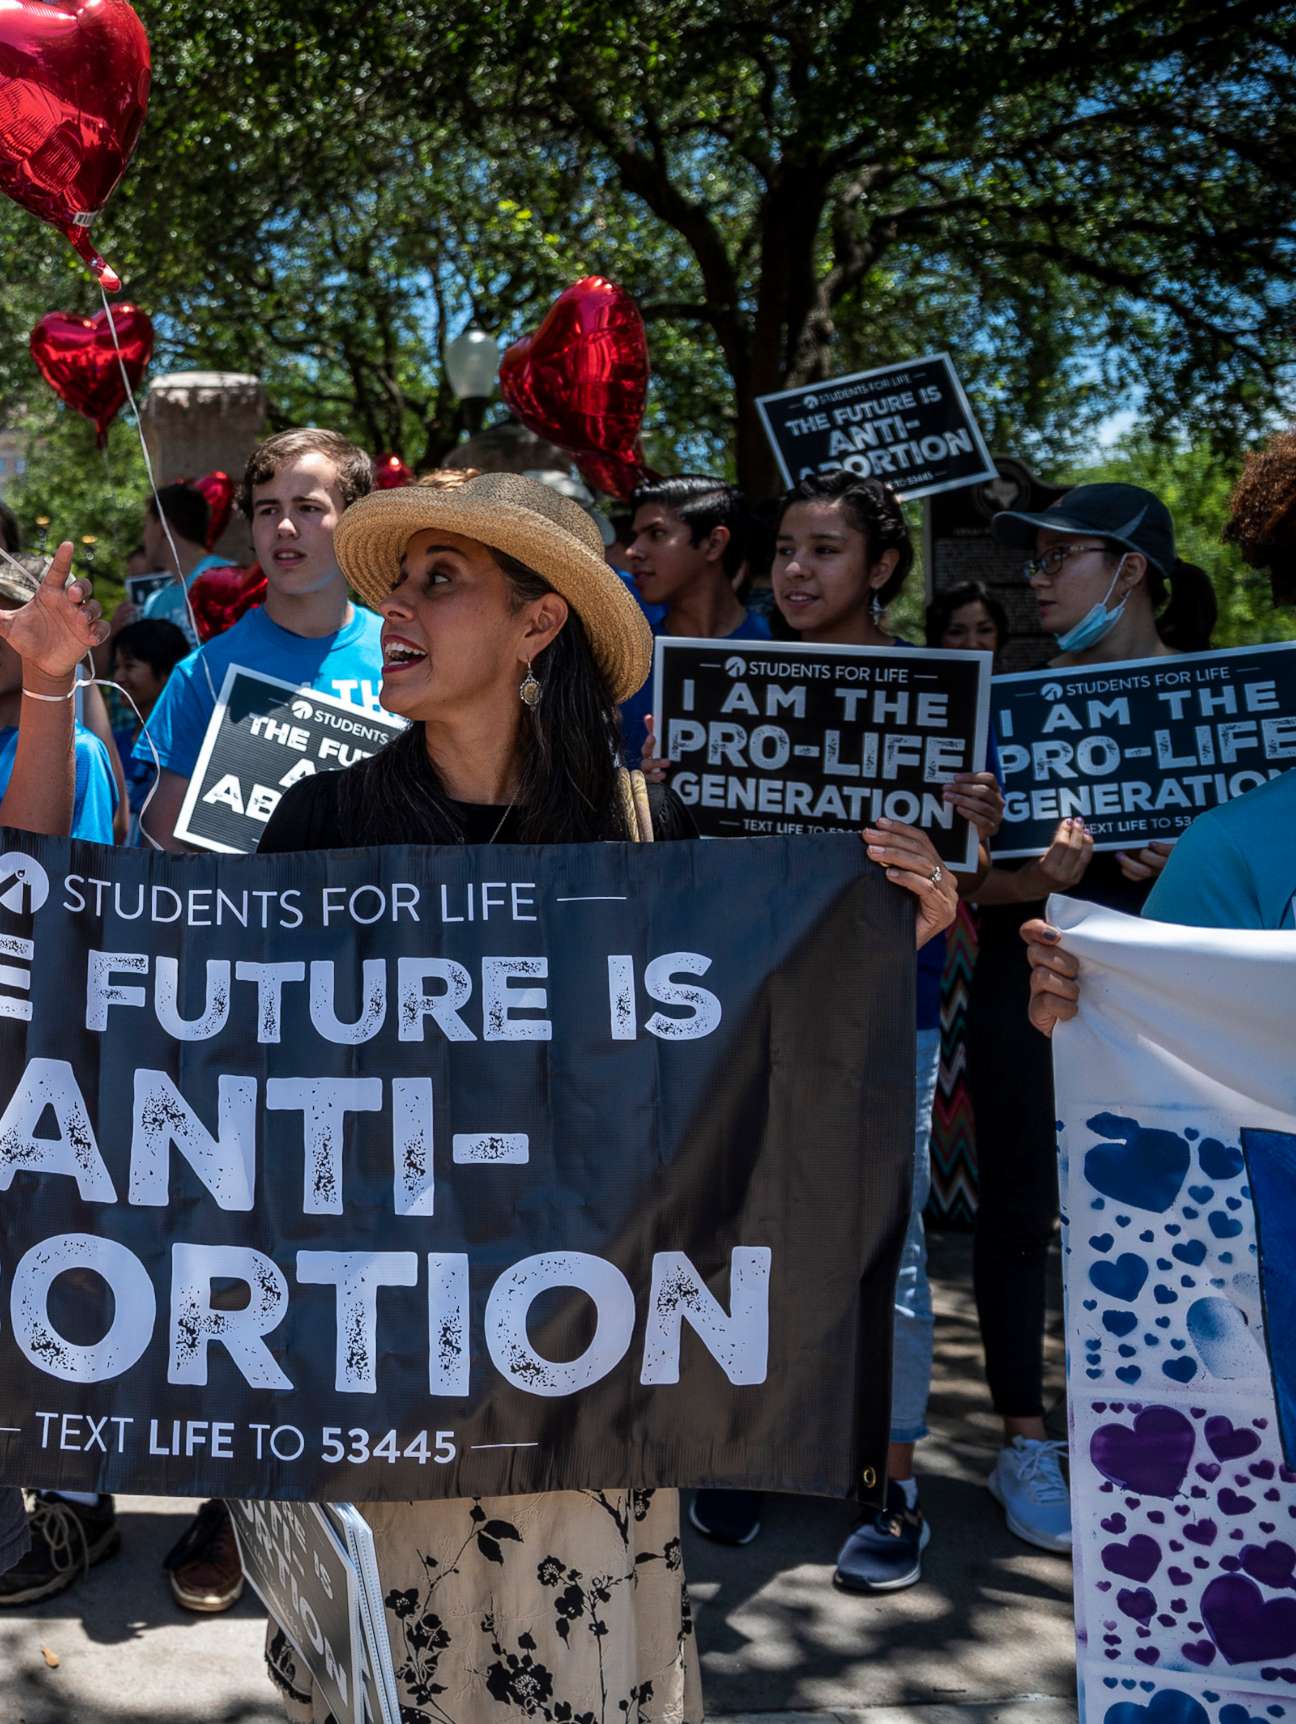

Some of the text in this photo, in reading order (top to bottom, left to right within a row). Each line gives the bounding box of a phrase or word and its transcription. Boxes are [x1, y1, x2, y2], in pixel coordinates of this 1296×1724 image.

[785, 385, 942, 436] THE FUTURE IS
[828, 415, 920, 457] ANTI-
[749, 661, 909, 683] STUDENTS FOR LIFE
[1066, 666, 1230, 696] STUDENTS FOR LIFE
[314, 710, 389, 744] STUDENTS
[682, 679, 949, 728] I AM THE
[1000, 680, 1280, 737] I AM THE
[248, 713, 310, 751] THE
[668, 718, 966, 784] PRO-LIFE
[996, 716, 1296, 784] PRO-LIFE
[671, 771, 953, 829] GENERATION
[1002, 769, 1284, 823] GENERATIO
[744, 819, 773, 832] TEXT
[776, 821, 803, 834] LIFE
[1084, 821, 1113, 835] EXT
[1118, 819, 1148, 833] LIFE
[1151, 817, 1171, 829] TO
[63, 874, 537, 928] STUDENTS FOR LIFE
[86, 949, 552, 1045] FUTURE
[607, 951, 722, 1042] IS
[35, 1411, 456, 1465] TEXT LIFE TO 53445
